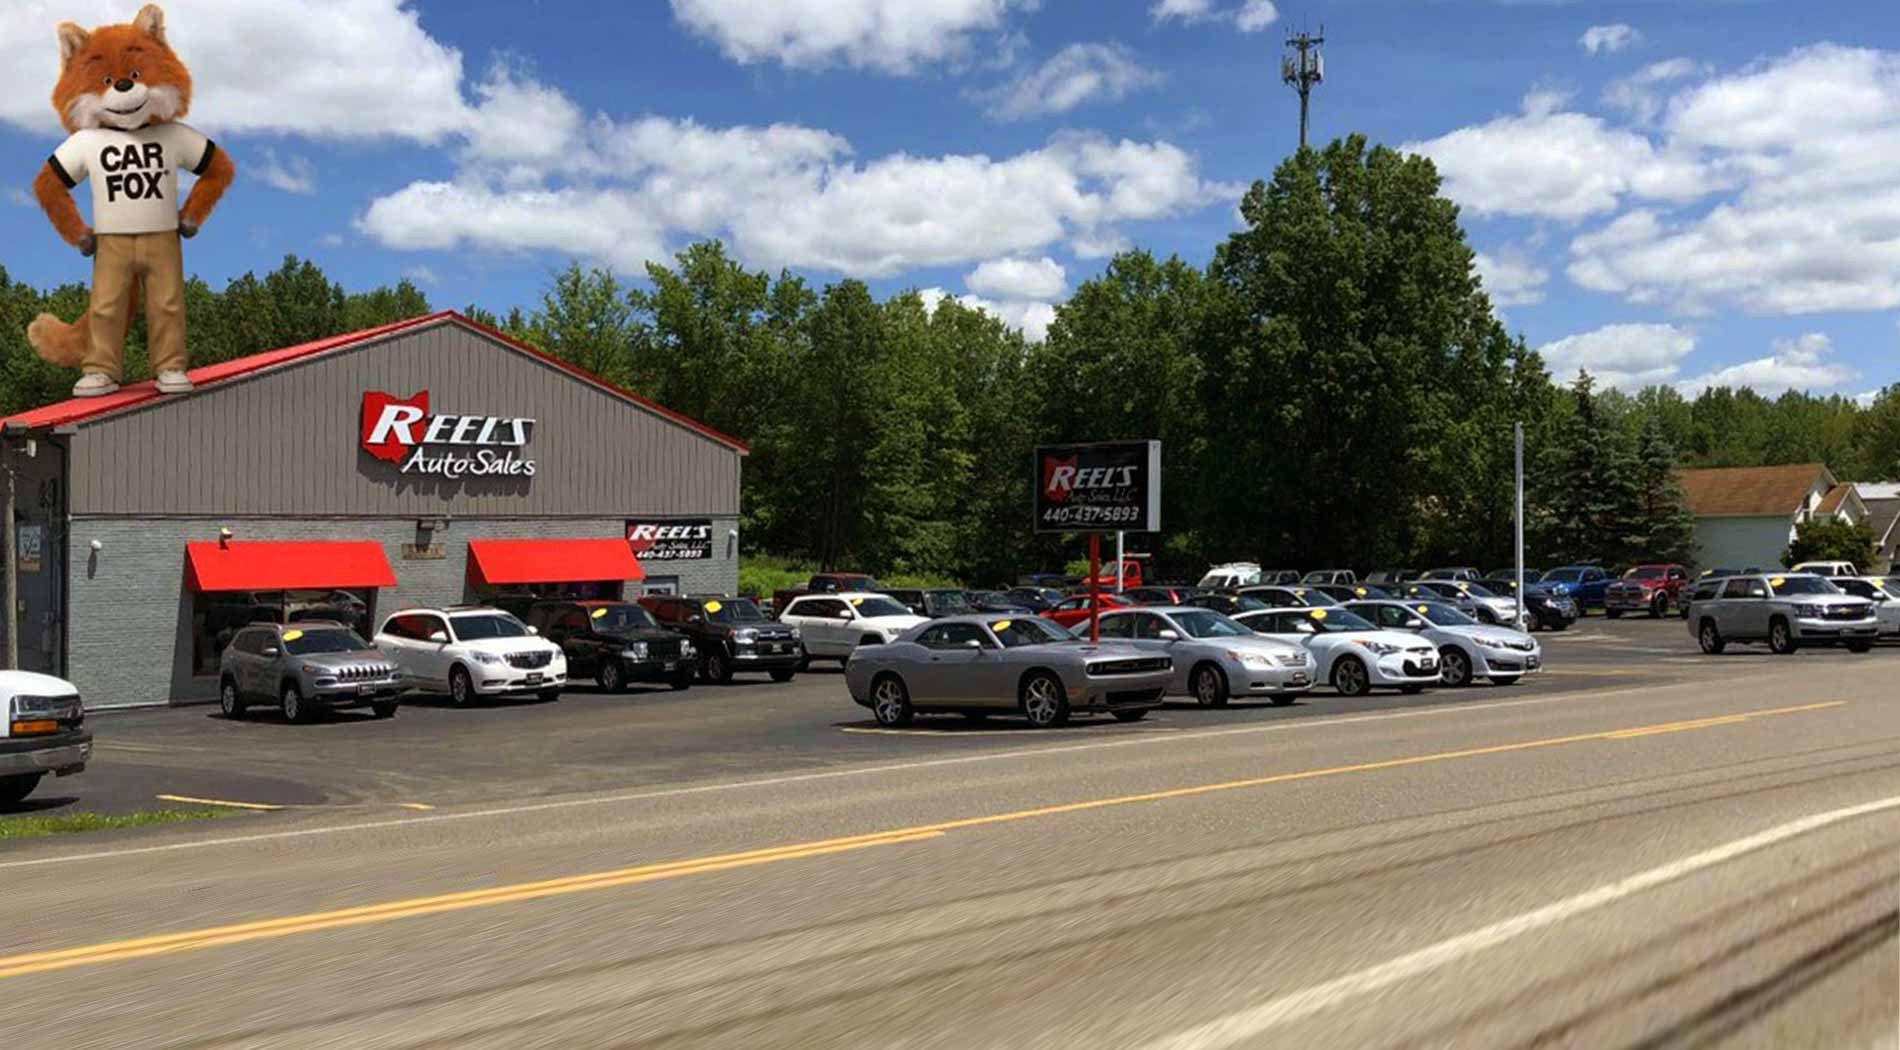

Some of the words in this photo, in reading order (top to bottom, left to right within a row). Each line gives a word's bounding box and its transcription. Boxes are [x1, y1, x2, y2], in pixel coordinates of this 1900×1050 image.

[100, 142, 164, 172] CAR
[106, 171, 164, 202] FOX
[367, 404, 536, 445] REEL'S
[470, 449, 536, 476] Sales
[1048, 465, 1138, 492] REEL'S
[630, 523, 712, 541] REEL'S
